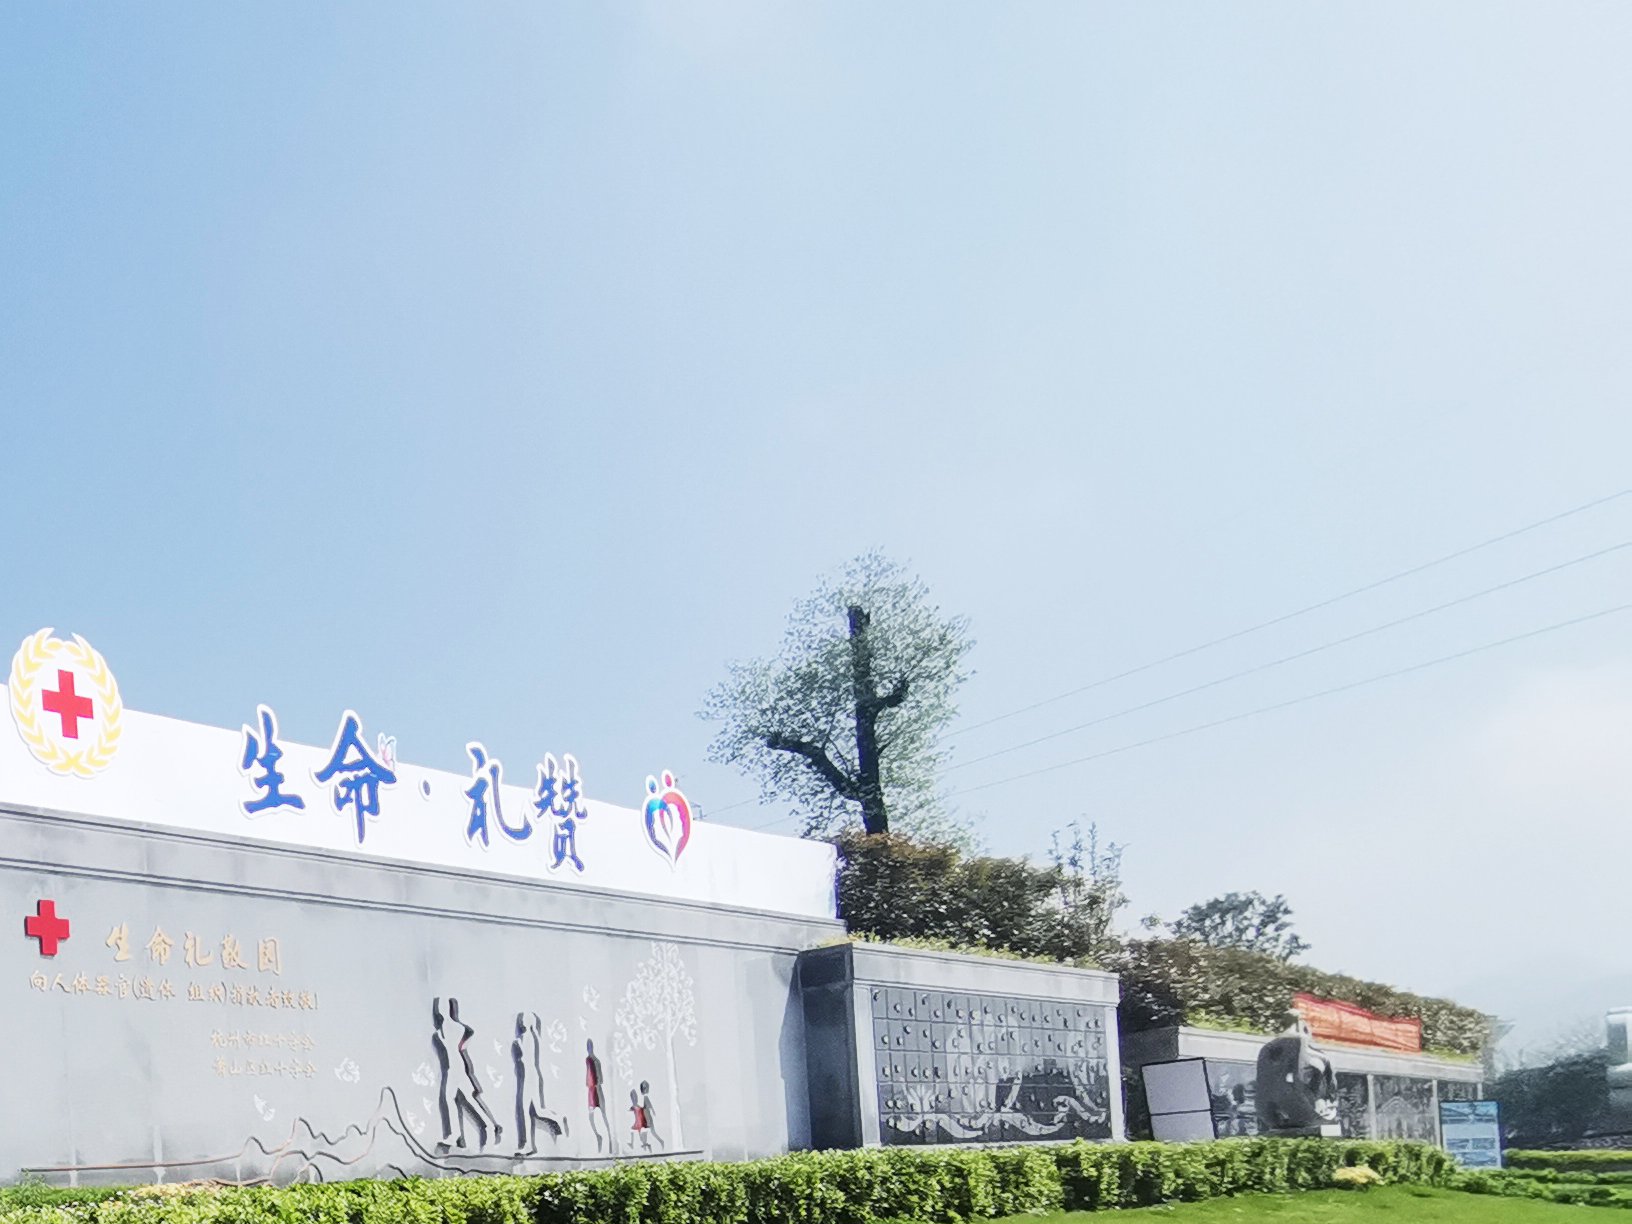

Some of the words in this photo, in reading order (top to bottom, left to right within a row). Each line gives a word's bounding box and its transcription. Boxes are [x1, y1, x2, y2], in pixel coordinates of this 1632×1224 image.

[105, 920, 283, 977] 生命礼敬园
